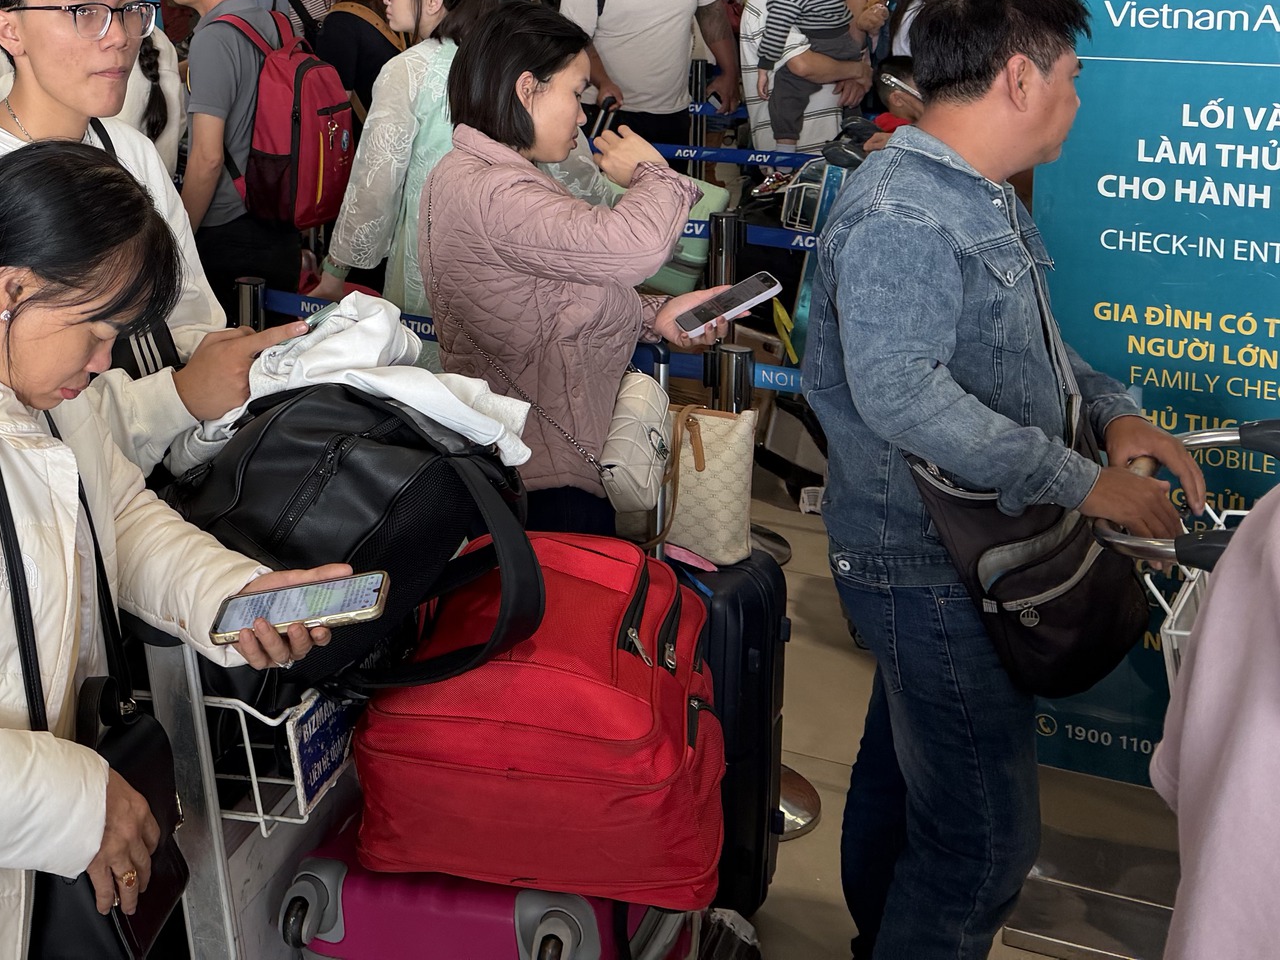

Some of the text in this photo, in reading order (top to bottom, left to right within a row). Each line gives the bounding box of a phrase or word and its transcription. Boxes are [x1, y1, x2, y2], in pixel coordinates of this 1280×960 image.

[1104, 0, 1249, 32] Vietnam
[688, 103, 703, 113] CV
[1182, 97, 1234, 130] LỐI
[675, 148, 698, 158] ACV
[747, 153, 771, 164] ACV
[1137, 135, 1207, 166] LÀM
[1097, 174, 1271, 209] CHO HÀNH
[683, 222, 706, 236] CV
[791, 234, 819, 247] AC
[1100, 229, 1225, 259] CHECK-IN
[1093, 302, 1258, 336] GIA ĐÌNH CÓ
[1128, 335, 1279, 370] NGƯỜI LỚN
[1130, 366, 1221, 393] FAMILY
[1140, 406, 1178, 431] HỦ
[1065, 724, 1159, 755] 1900 110
